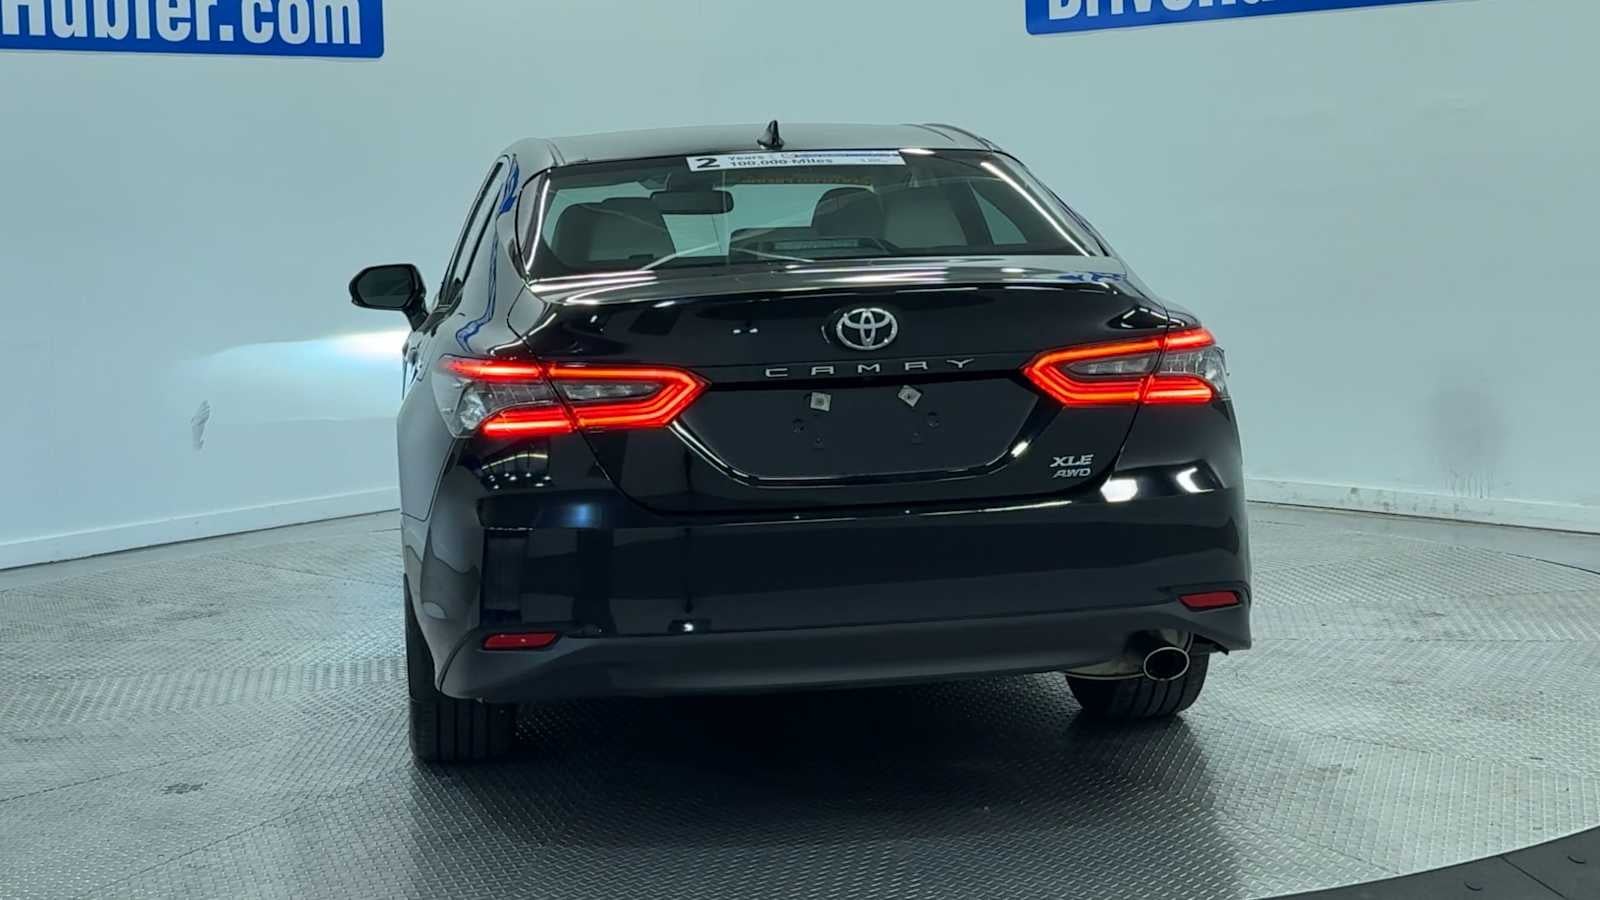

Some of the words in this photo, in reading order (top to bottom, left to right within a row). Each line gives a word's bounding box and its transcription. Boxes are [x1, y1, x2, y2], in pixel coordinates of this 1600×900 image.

[695, 157, 721, 169] 2
[765, 358, 975, 377] CAMRY
[1049, 454, 1094, 467] XLE
[1051, 467, 1091, 478] AWD
